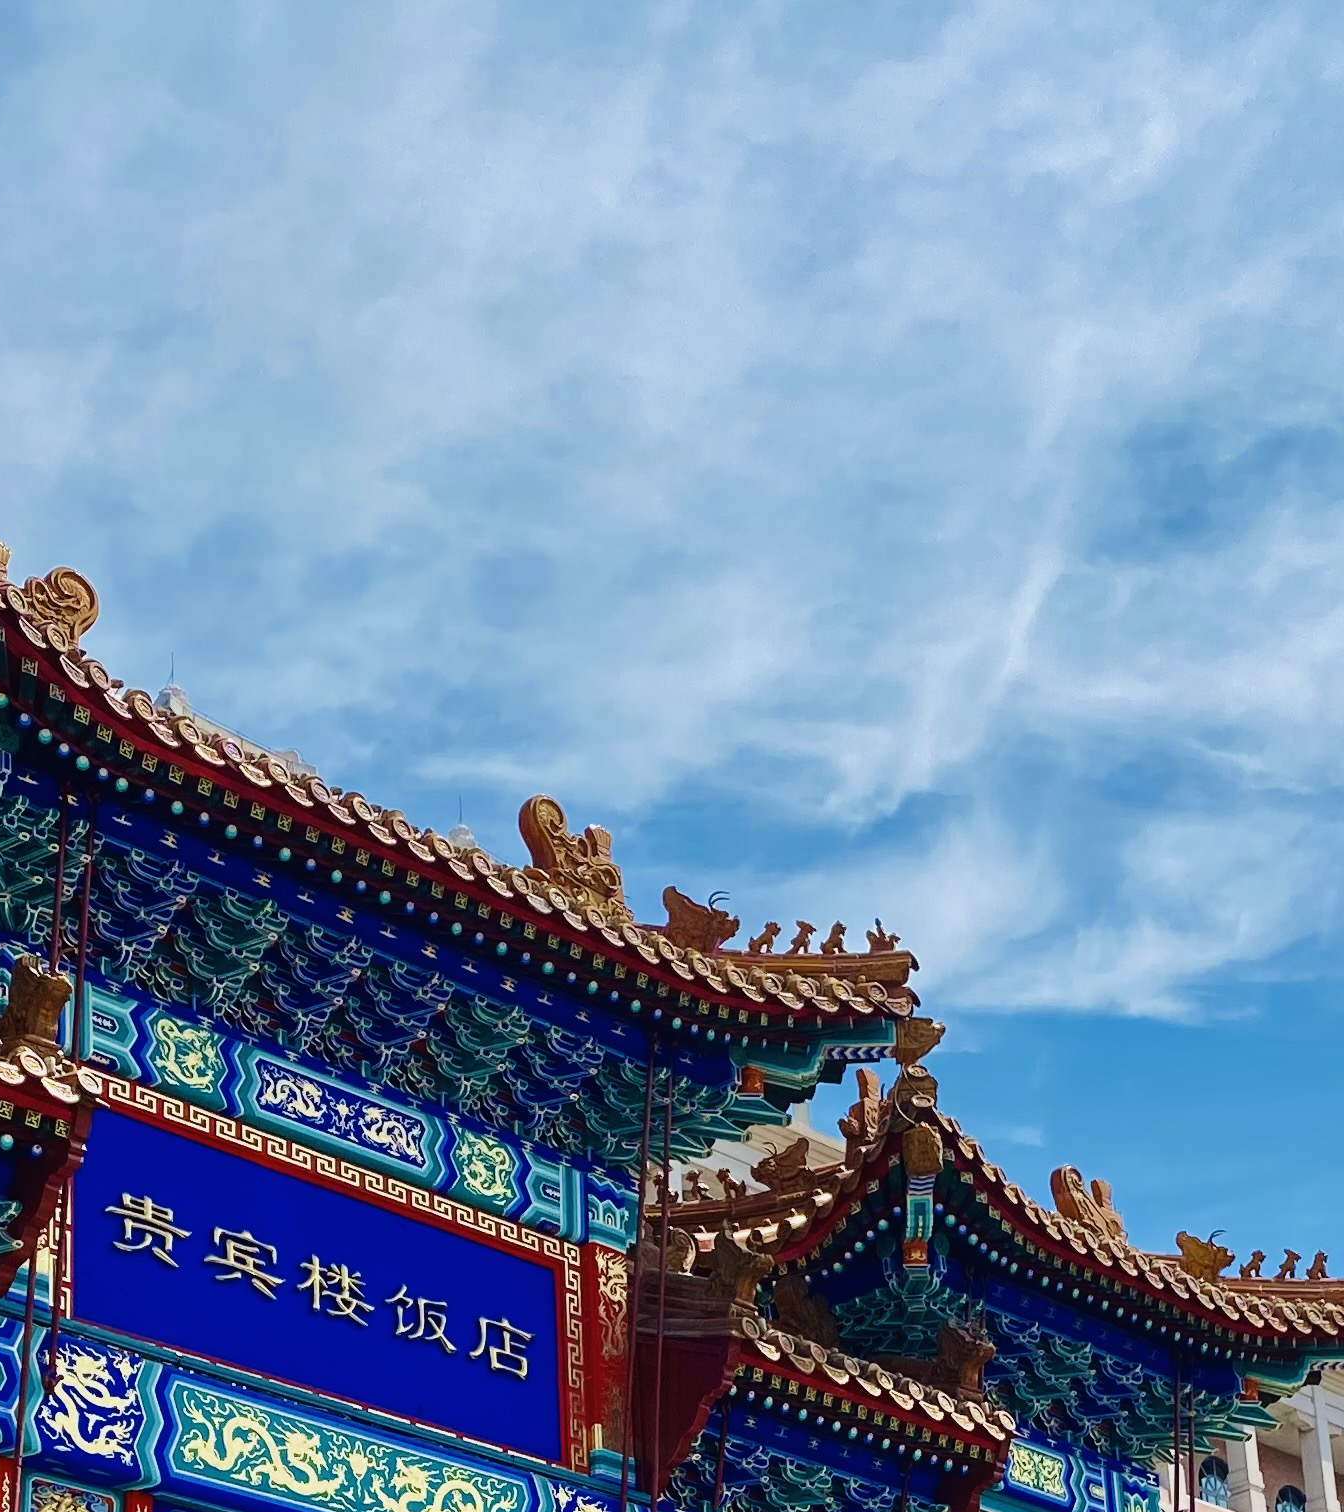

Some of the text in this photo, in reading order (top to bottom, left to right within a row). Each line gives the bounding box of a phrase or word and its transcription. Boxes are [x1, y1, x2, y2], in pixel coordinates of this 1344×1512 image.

[105, 1192, 536, 1380] 贵宾楼饭店
